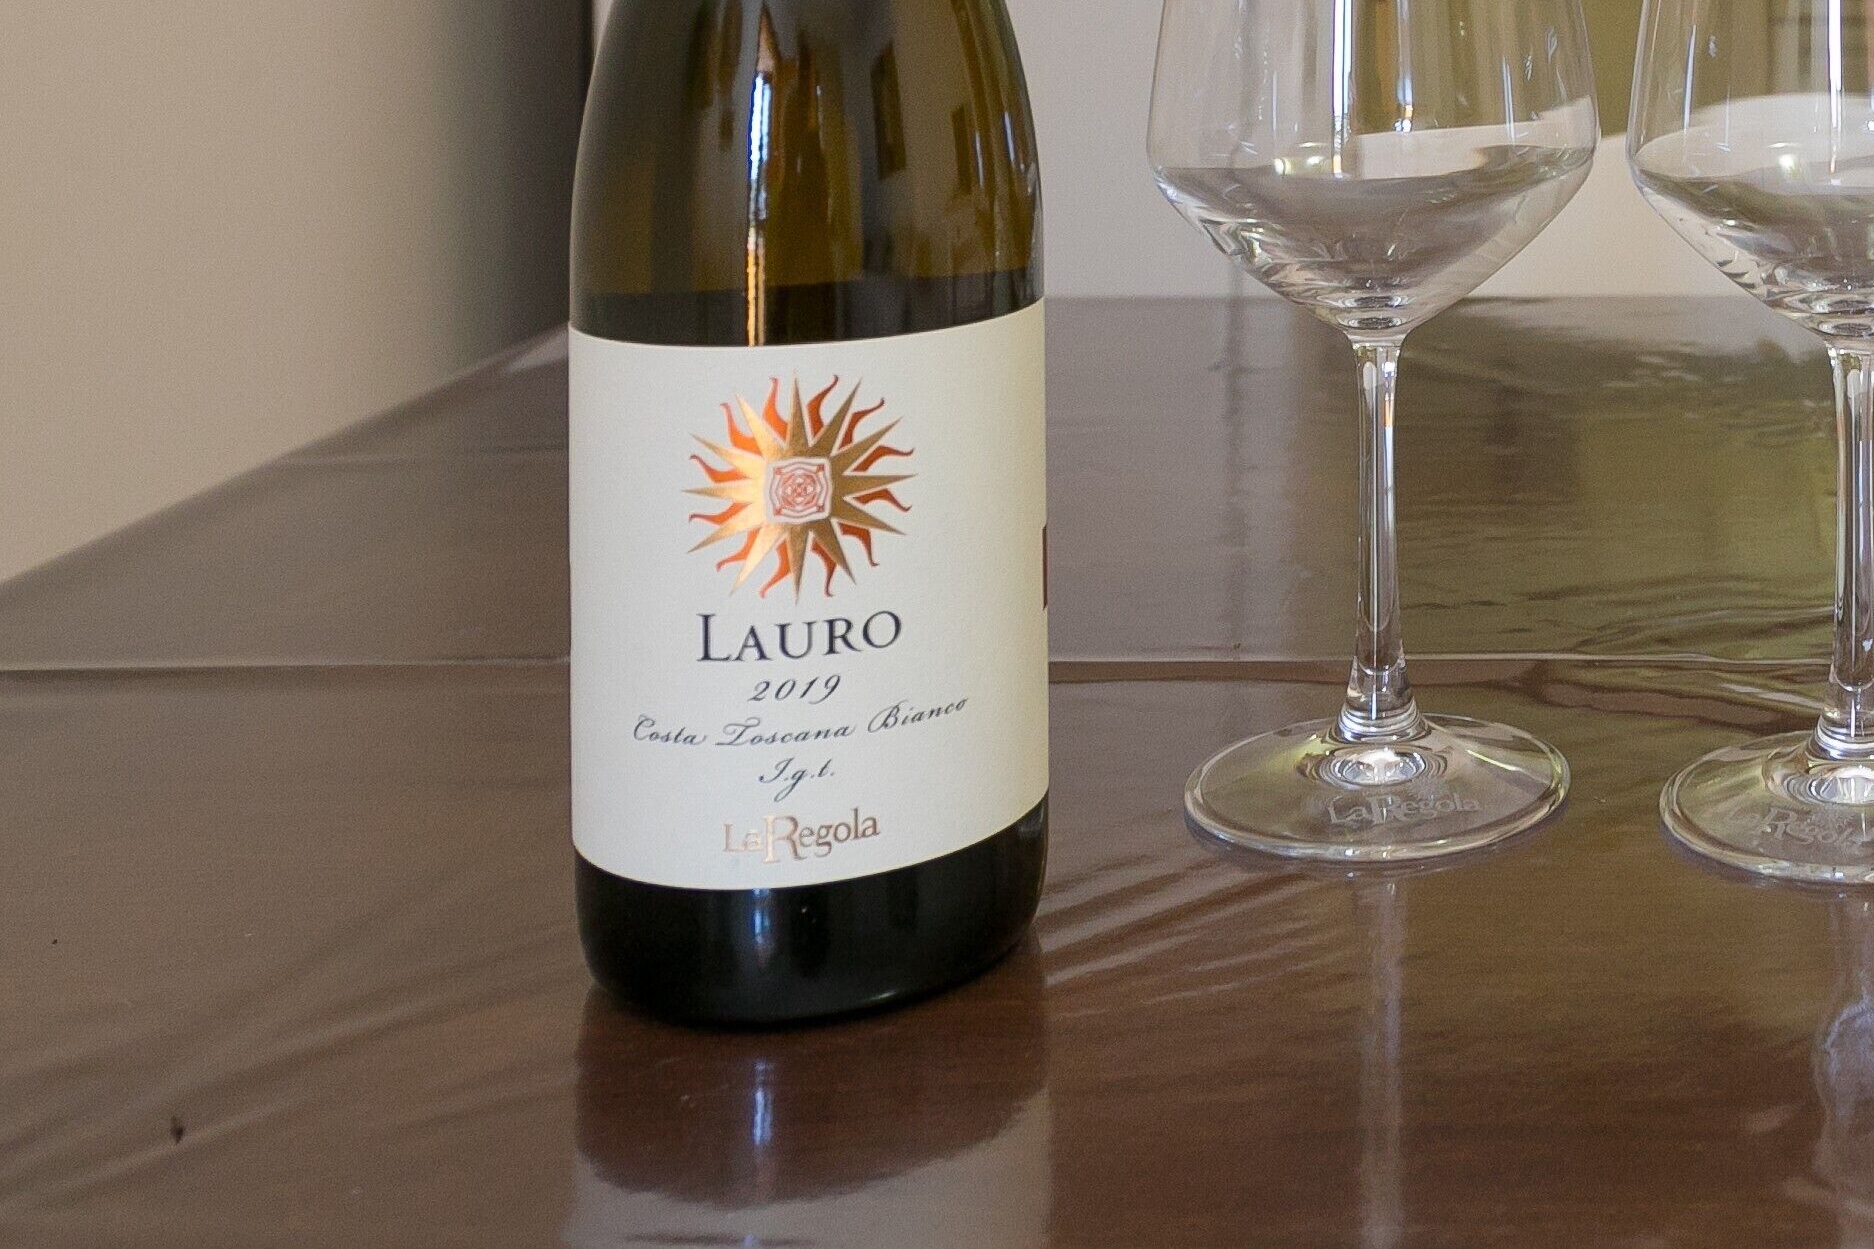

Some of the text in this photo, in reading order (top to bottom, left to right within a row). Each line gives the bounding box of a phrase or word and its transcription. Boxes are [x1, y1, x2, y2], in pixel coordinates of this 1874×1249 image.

[696, 610, 902, 662] LAURO
[747, 673, 843, 705] 2019
[633, 697, 969, 747] Costa Toscana Bianco
